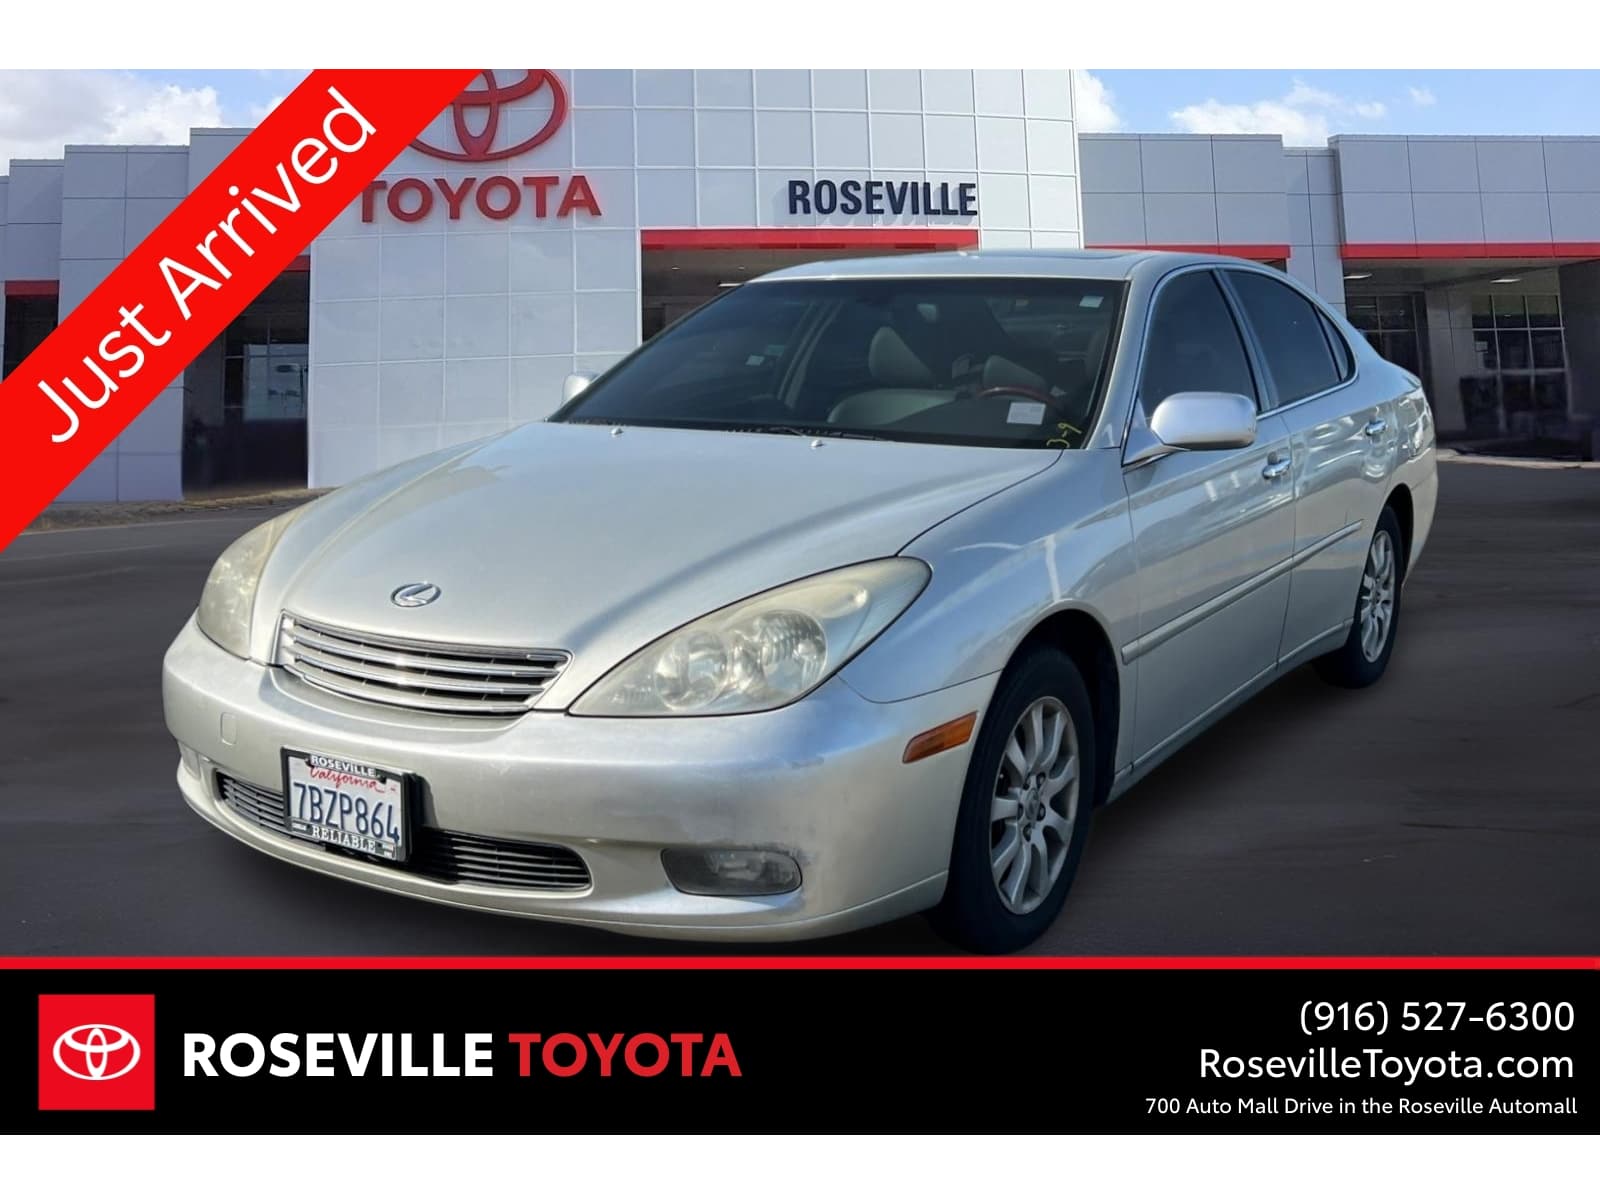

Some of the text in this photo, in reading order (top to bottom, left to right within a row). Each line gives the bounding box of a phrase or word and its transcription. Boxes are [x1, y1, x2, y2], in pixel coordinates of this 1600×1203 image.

[360, 175, 602, 223] TOYOTA
[787, 179, 978, 216] ROSEVILLE
[308, 766, 385, 793] California
[310, 755, 377, 778] ROSEVILLE
[293, 781, 400, 845] 7BZP864
[311, 825, 377, 852] RELIABLE
